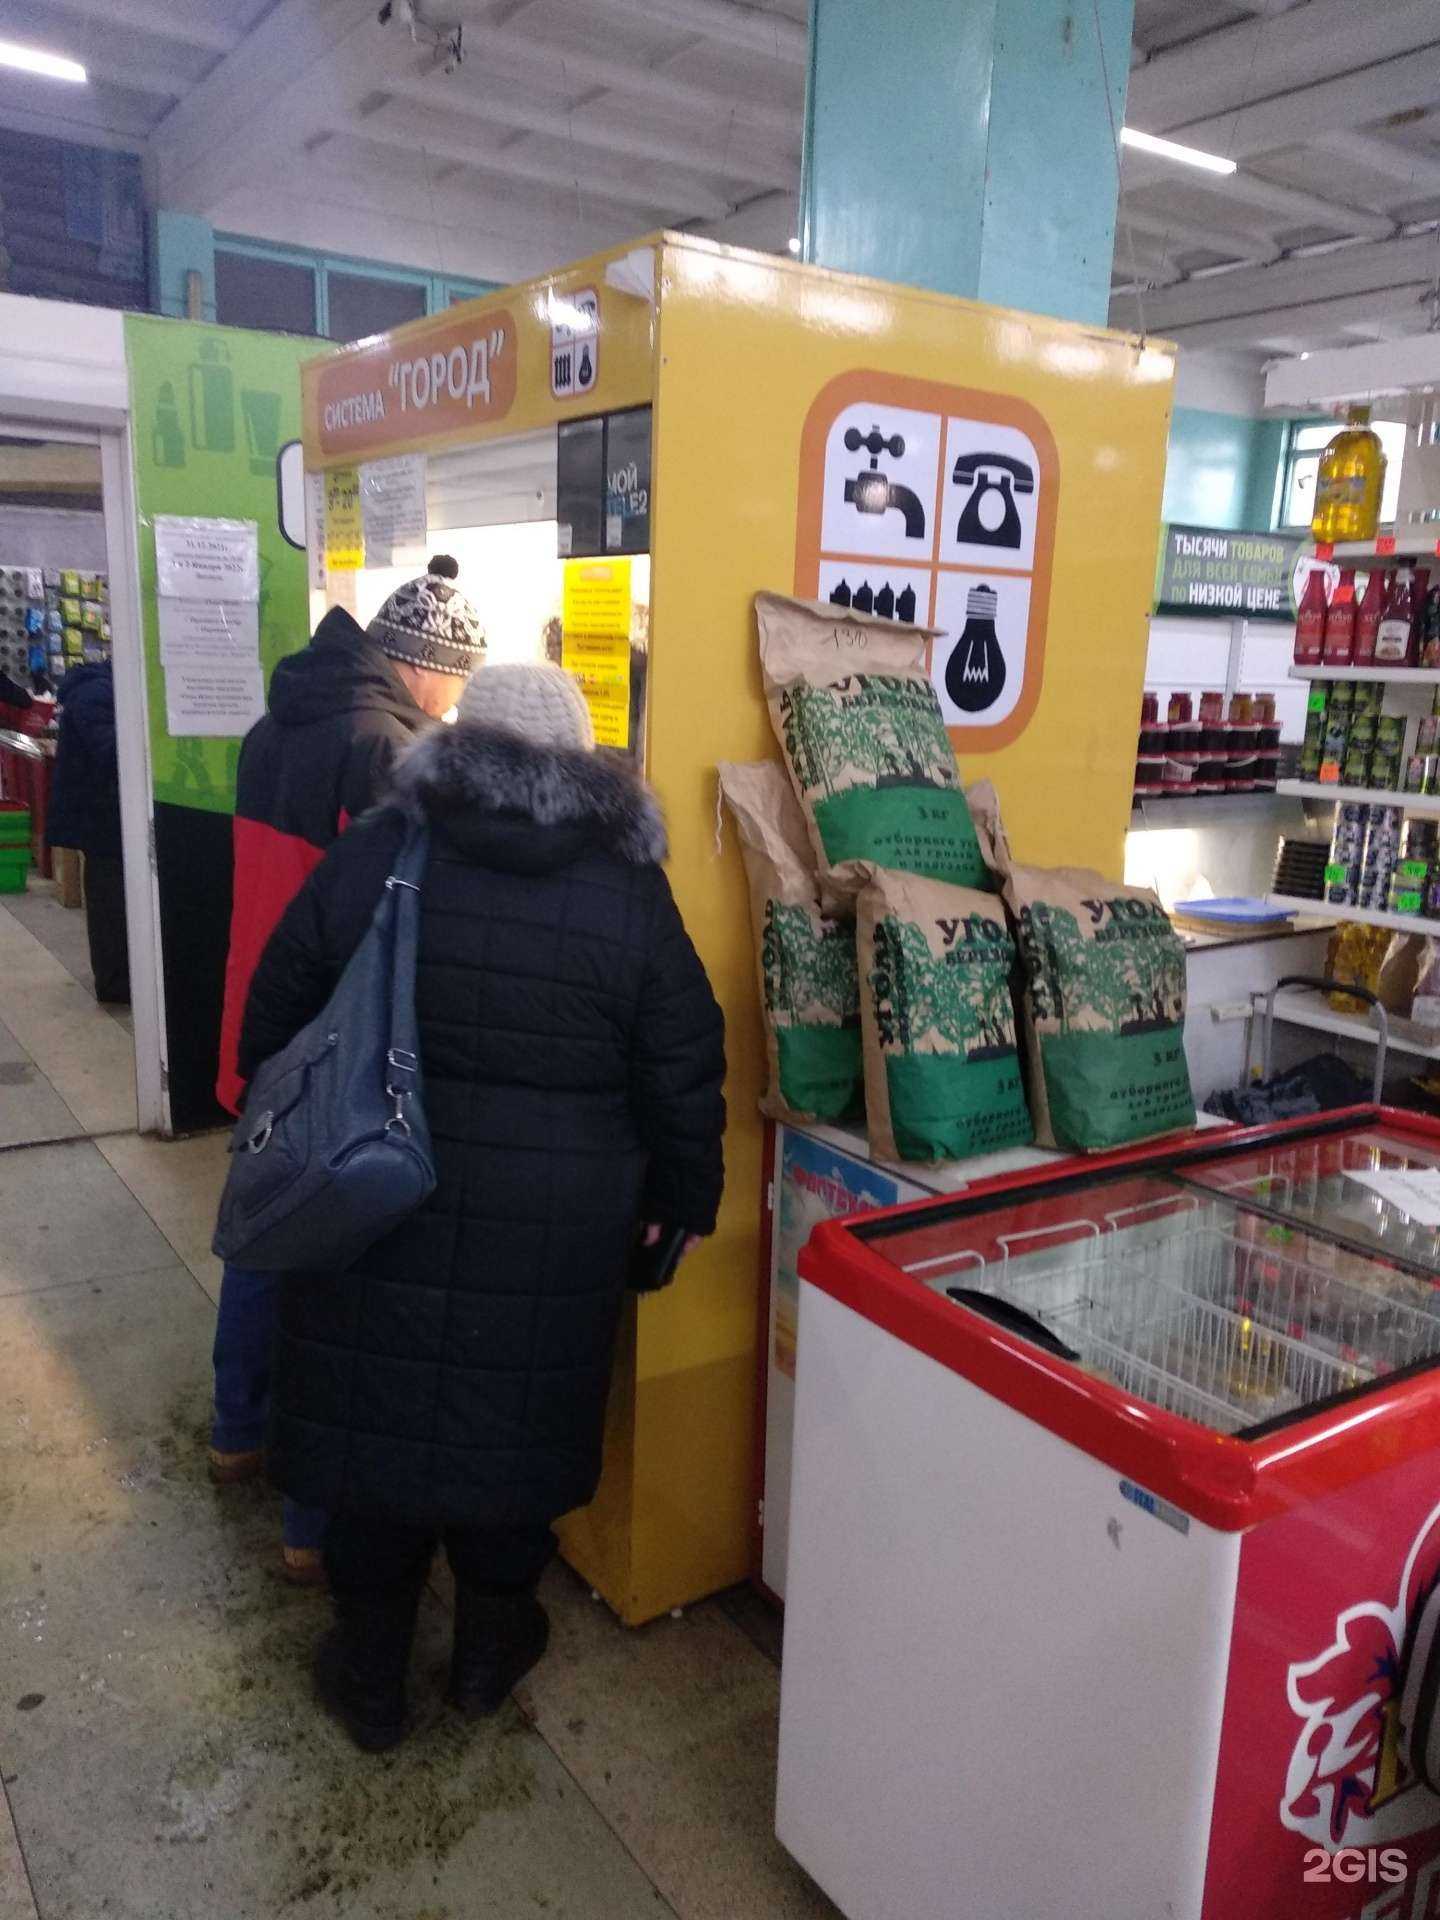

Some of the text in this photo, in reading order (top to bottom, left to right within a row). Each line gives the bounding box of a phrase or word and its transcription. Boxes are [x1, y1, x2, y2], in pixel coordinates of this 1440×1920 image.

[324, 390, 385, 432] СИСТЕМА
[1175, 534, 1284, 565] ТЫСЯЧИ ТОВАРОВ
[1189, 582, 1243, 609] НИЗКОЙ
[1247, 587, 1281, 612] ЦЕНЕ
